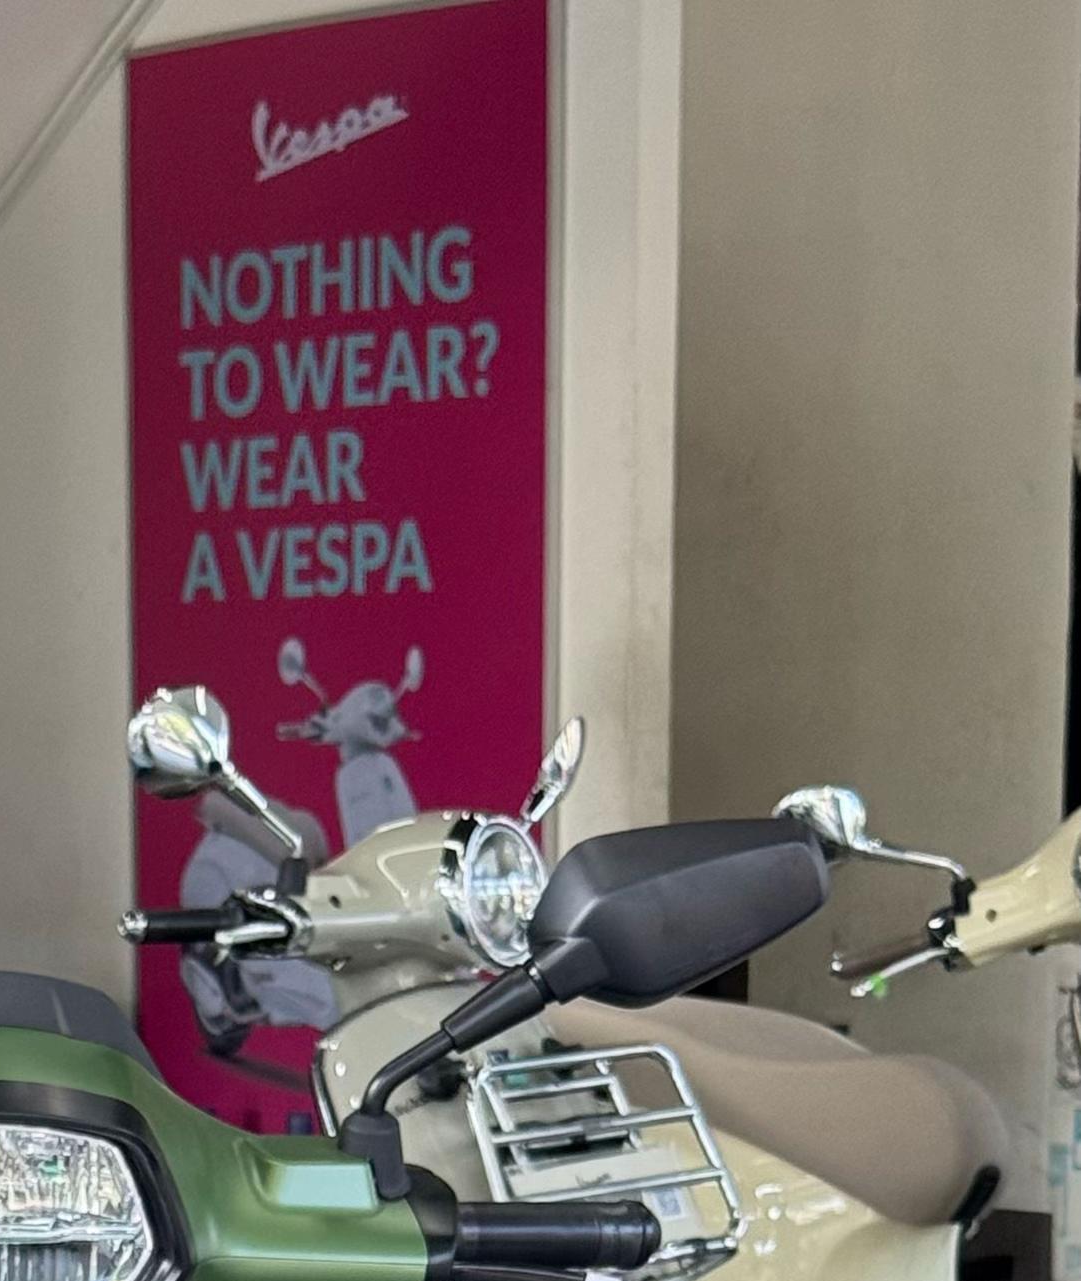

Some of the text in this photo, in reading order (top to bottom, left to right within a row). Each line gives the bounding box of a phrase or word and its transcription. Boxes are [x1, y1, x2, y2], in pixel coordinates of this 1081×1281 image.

[252, 96, 409, 182] Vespa
[179, 224, 474, 330] NOTHING
[179, 319, 499, 421] TO WEAR?
[180, 428, 366, 512] WEAR
[181, 518, 433, 602] A VESPA
